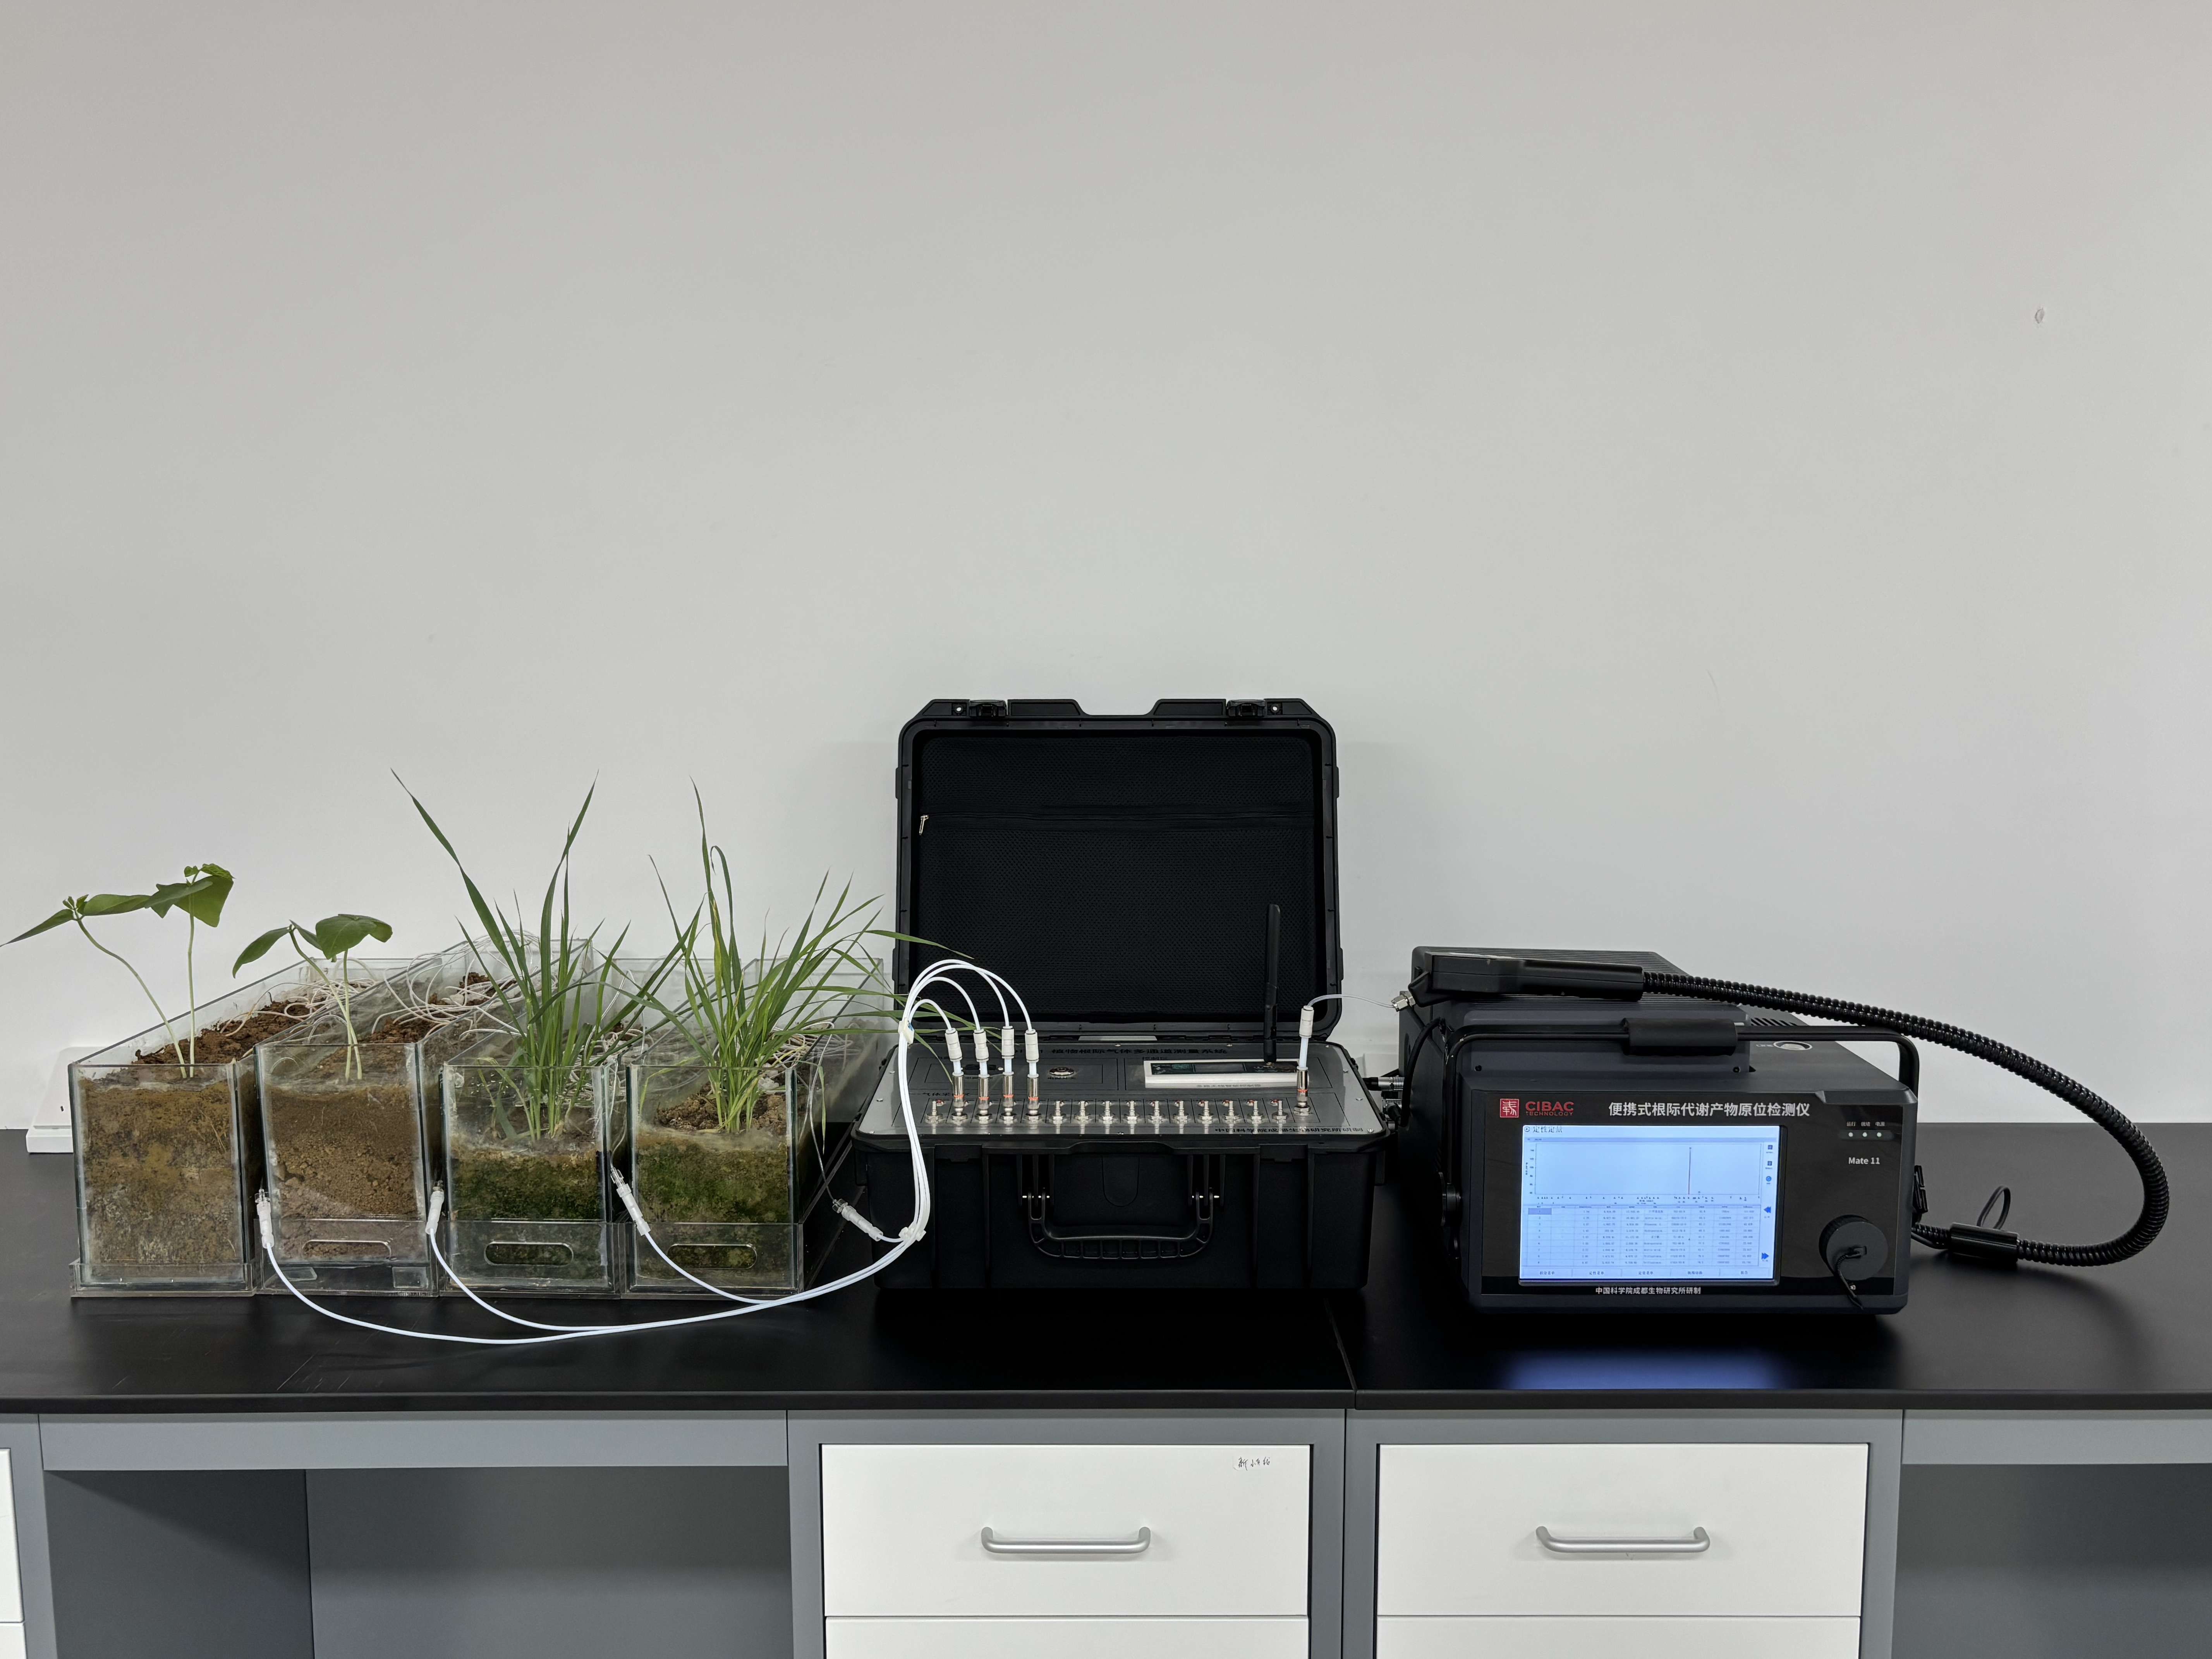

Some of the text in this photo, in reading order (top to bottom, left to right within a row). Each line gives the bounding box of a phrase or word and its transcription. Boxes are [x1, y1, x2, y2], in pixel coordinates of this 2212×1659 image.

[1525, 1101, 1574, 1111] CIBAC
[1608, 1102, 1810, 1116] 便携式根际代谢产物原位检测仪
